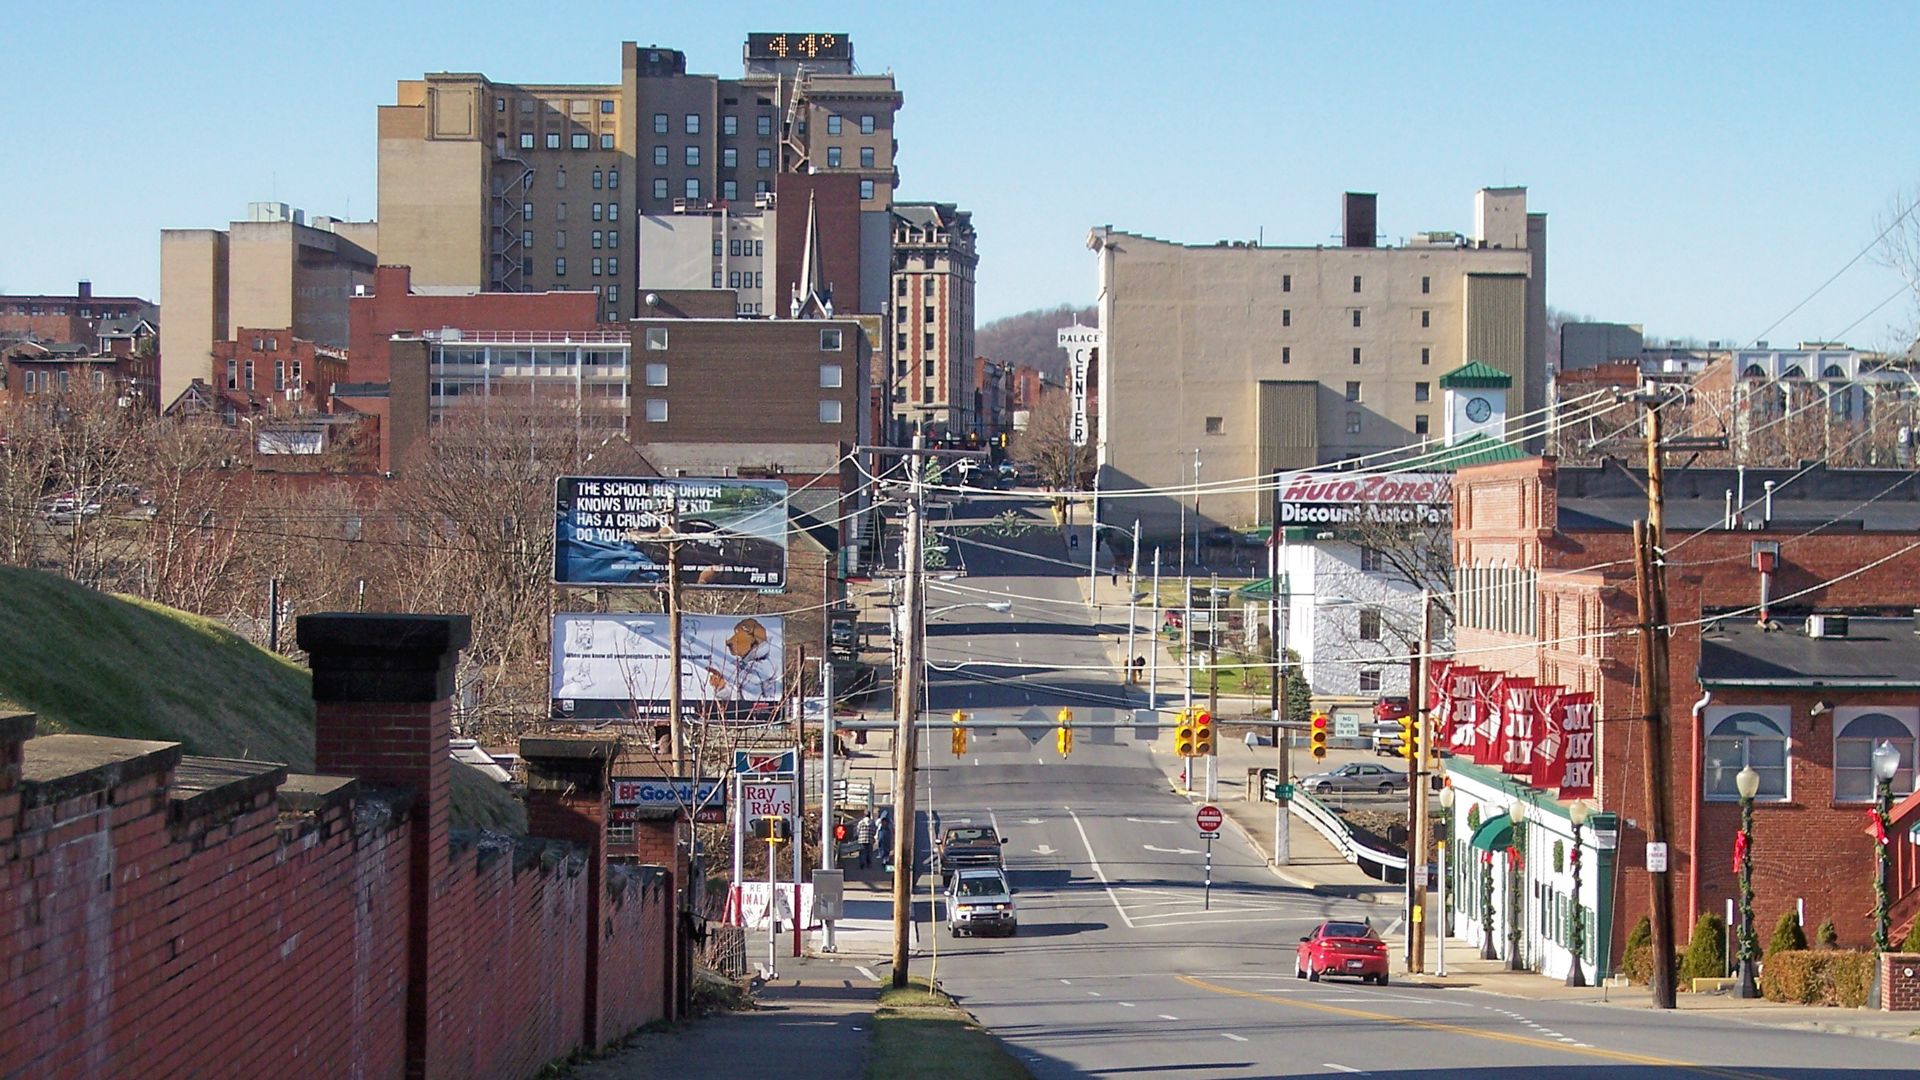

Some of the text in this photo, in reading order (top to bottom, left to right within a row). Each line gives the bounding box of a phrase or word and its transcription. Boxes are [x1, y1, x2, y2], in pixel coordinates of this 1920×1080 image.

[1060, 334, 1098, 342] PALACE
[1075, 349, 1083, 442] CENTER
[578, 482, 722, 498] THE SCHOOL BUS DRIVER
[577, 498, 621, 512] KNOWS
[624, 499, 653, 511] WHO
[1282, 503, 1360, 522] Discount
[576, 513, 601, 527] HAS
[604, 513, 614, 527] A
[617, 513, 657, 527] CRUSH
[576, 527, 593, 541] DO
[1563, 704, 1592, 730] JOY
[1503, 740, 1533, 764] JOY
[1565, 733, 1593, 759] JOY
[1562, 762, 1592, 787] JOY
[619, 784, 719, 800] BFGoodrch
[746, 787, 776, 802] Ray
[752, 801, 790, 816] Ray's
